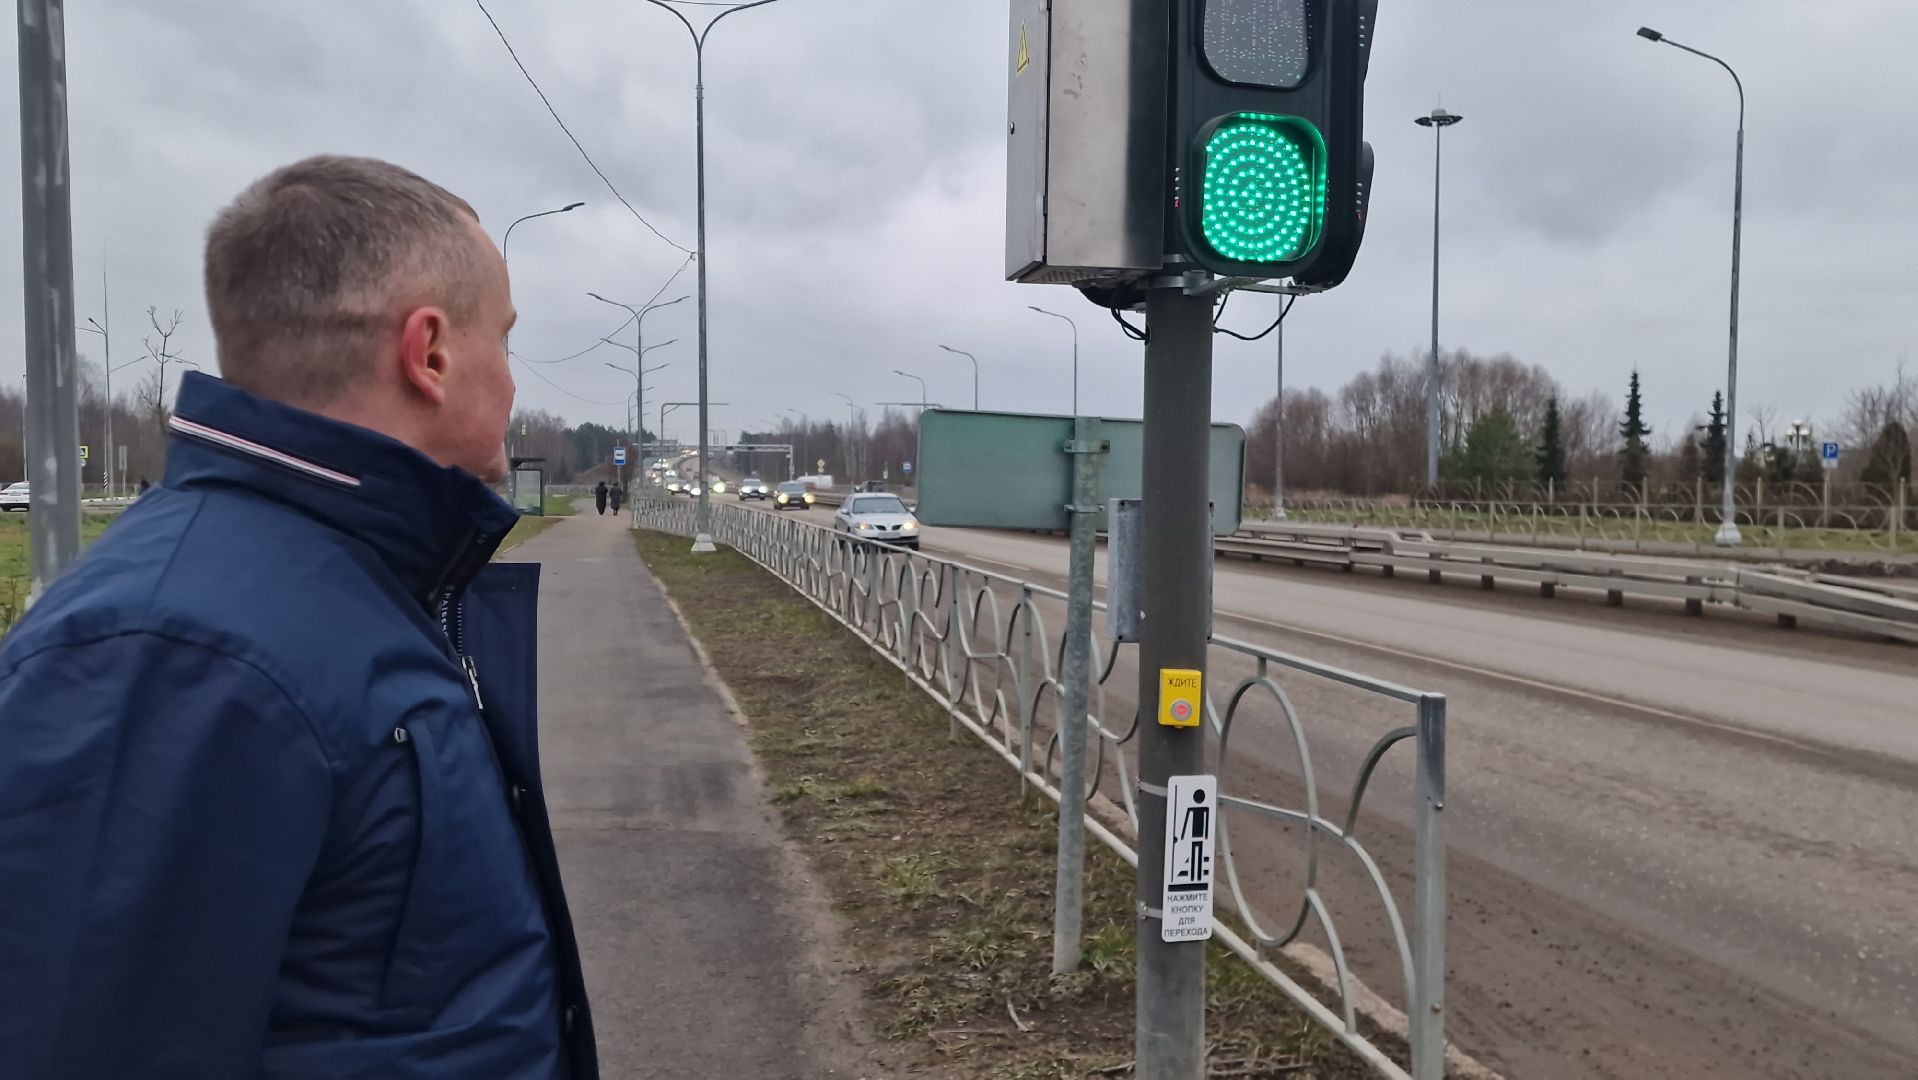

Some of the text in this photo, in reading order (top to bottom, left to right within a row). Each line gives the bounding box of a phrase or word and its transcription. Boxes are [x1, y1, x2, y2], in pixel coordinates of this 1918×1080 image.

[1167, 678, 1197, 688] ЖДИТЕ
[1167, 893, 1208, 902] НАЖМИТЕ
[1171, 905, 1204, 913] КНОПКУ
[1178, 917, 1195, 926] ДЛЯ
[1164, 928, 1208, 937] ПЕРЕХОДА
